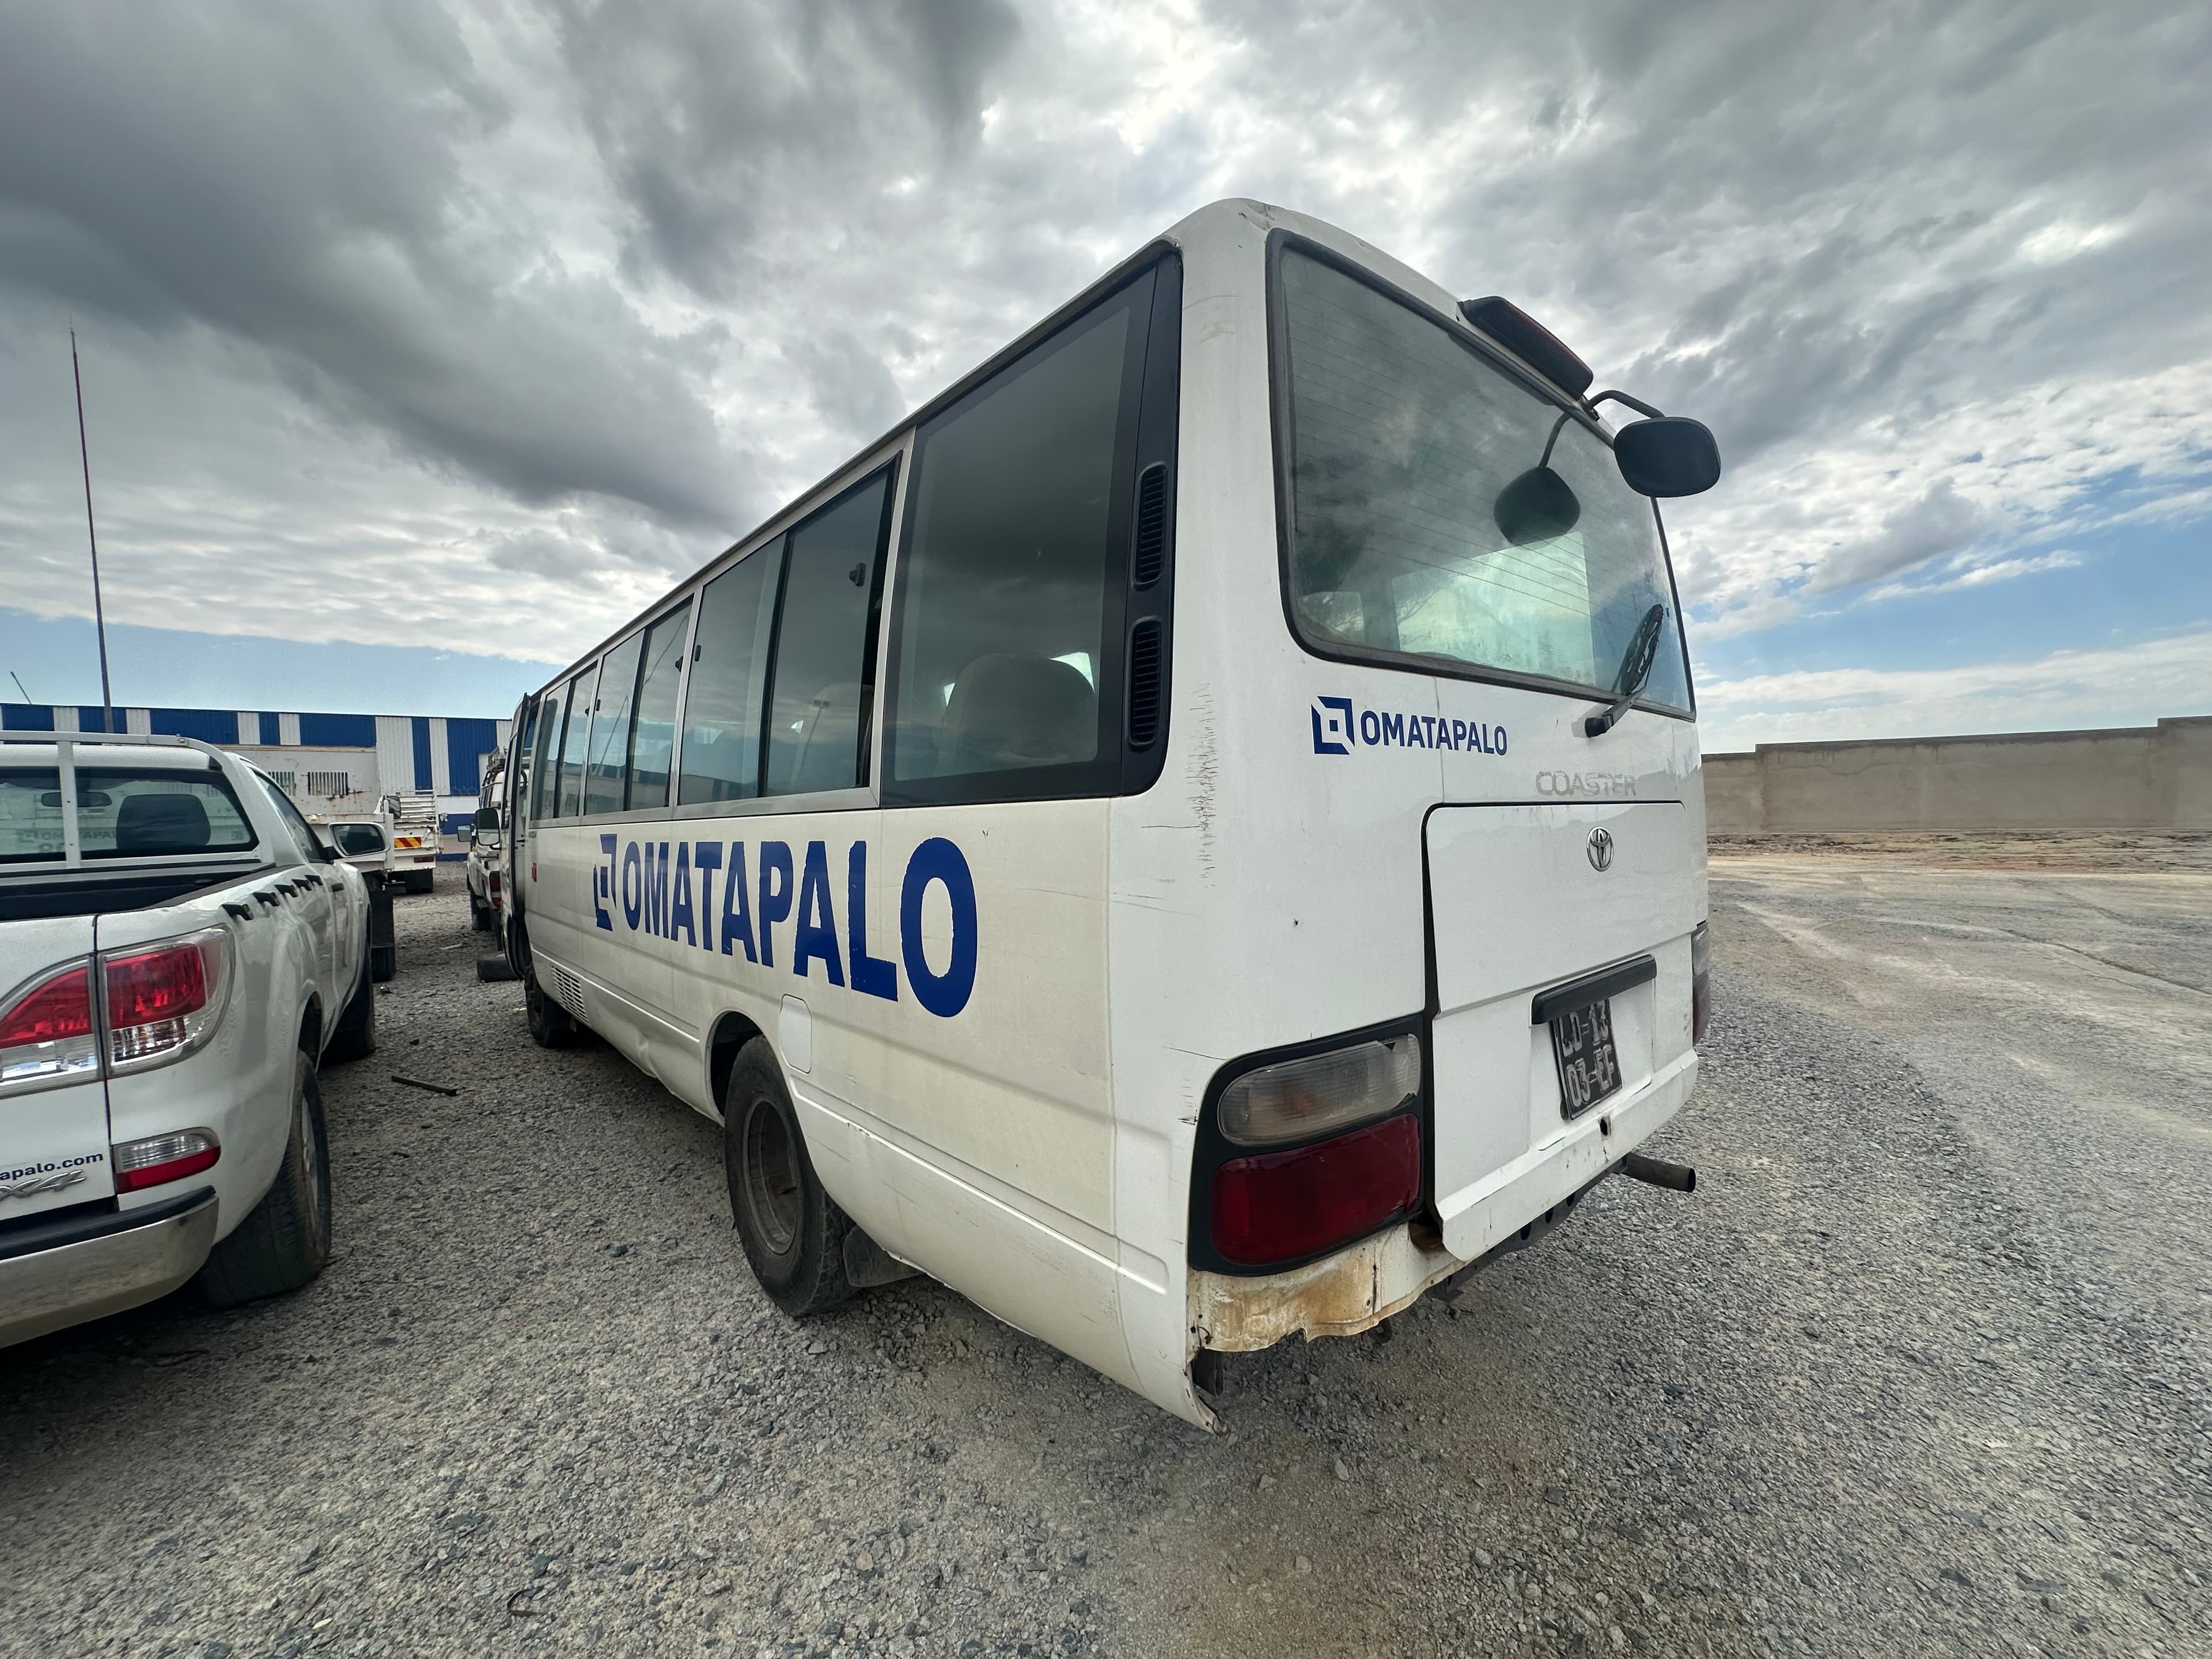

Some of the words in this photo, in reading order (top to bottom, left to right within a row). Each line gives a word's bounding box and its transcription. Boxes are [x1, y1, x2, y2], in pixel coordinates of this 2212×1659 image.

[1360, 710, 1508, 756] OMATAPALO
[1535, 770, 1637, 797] COASTER
[622, 836, 978, 1018] OMATAPALO
